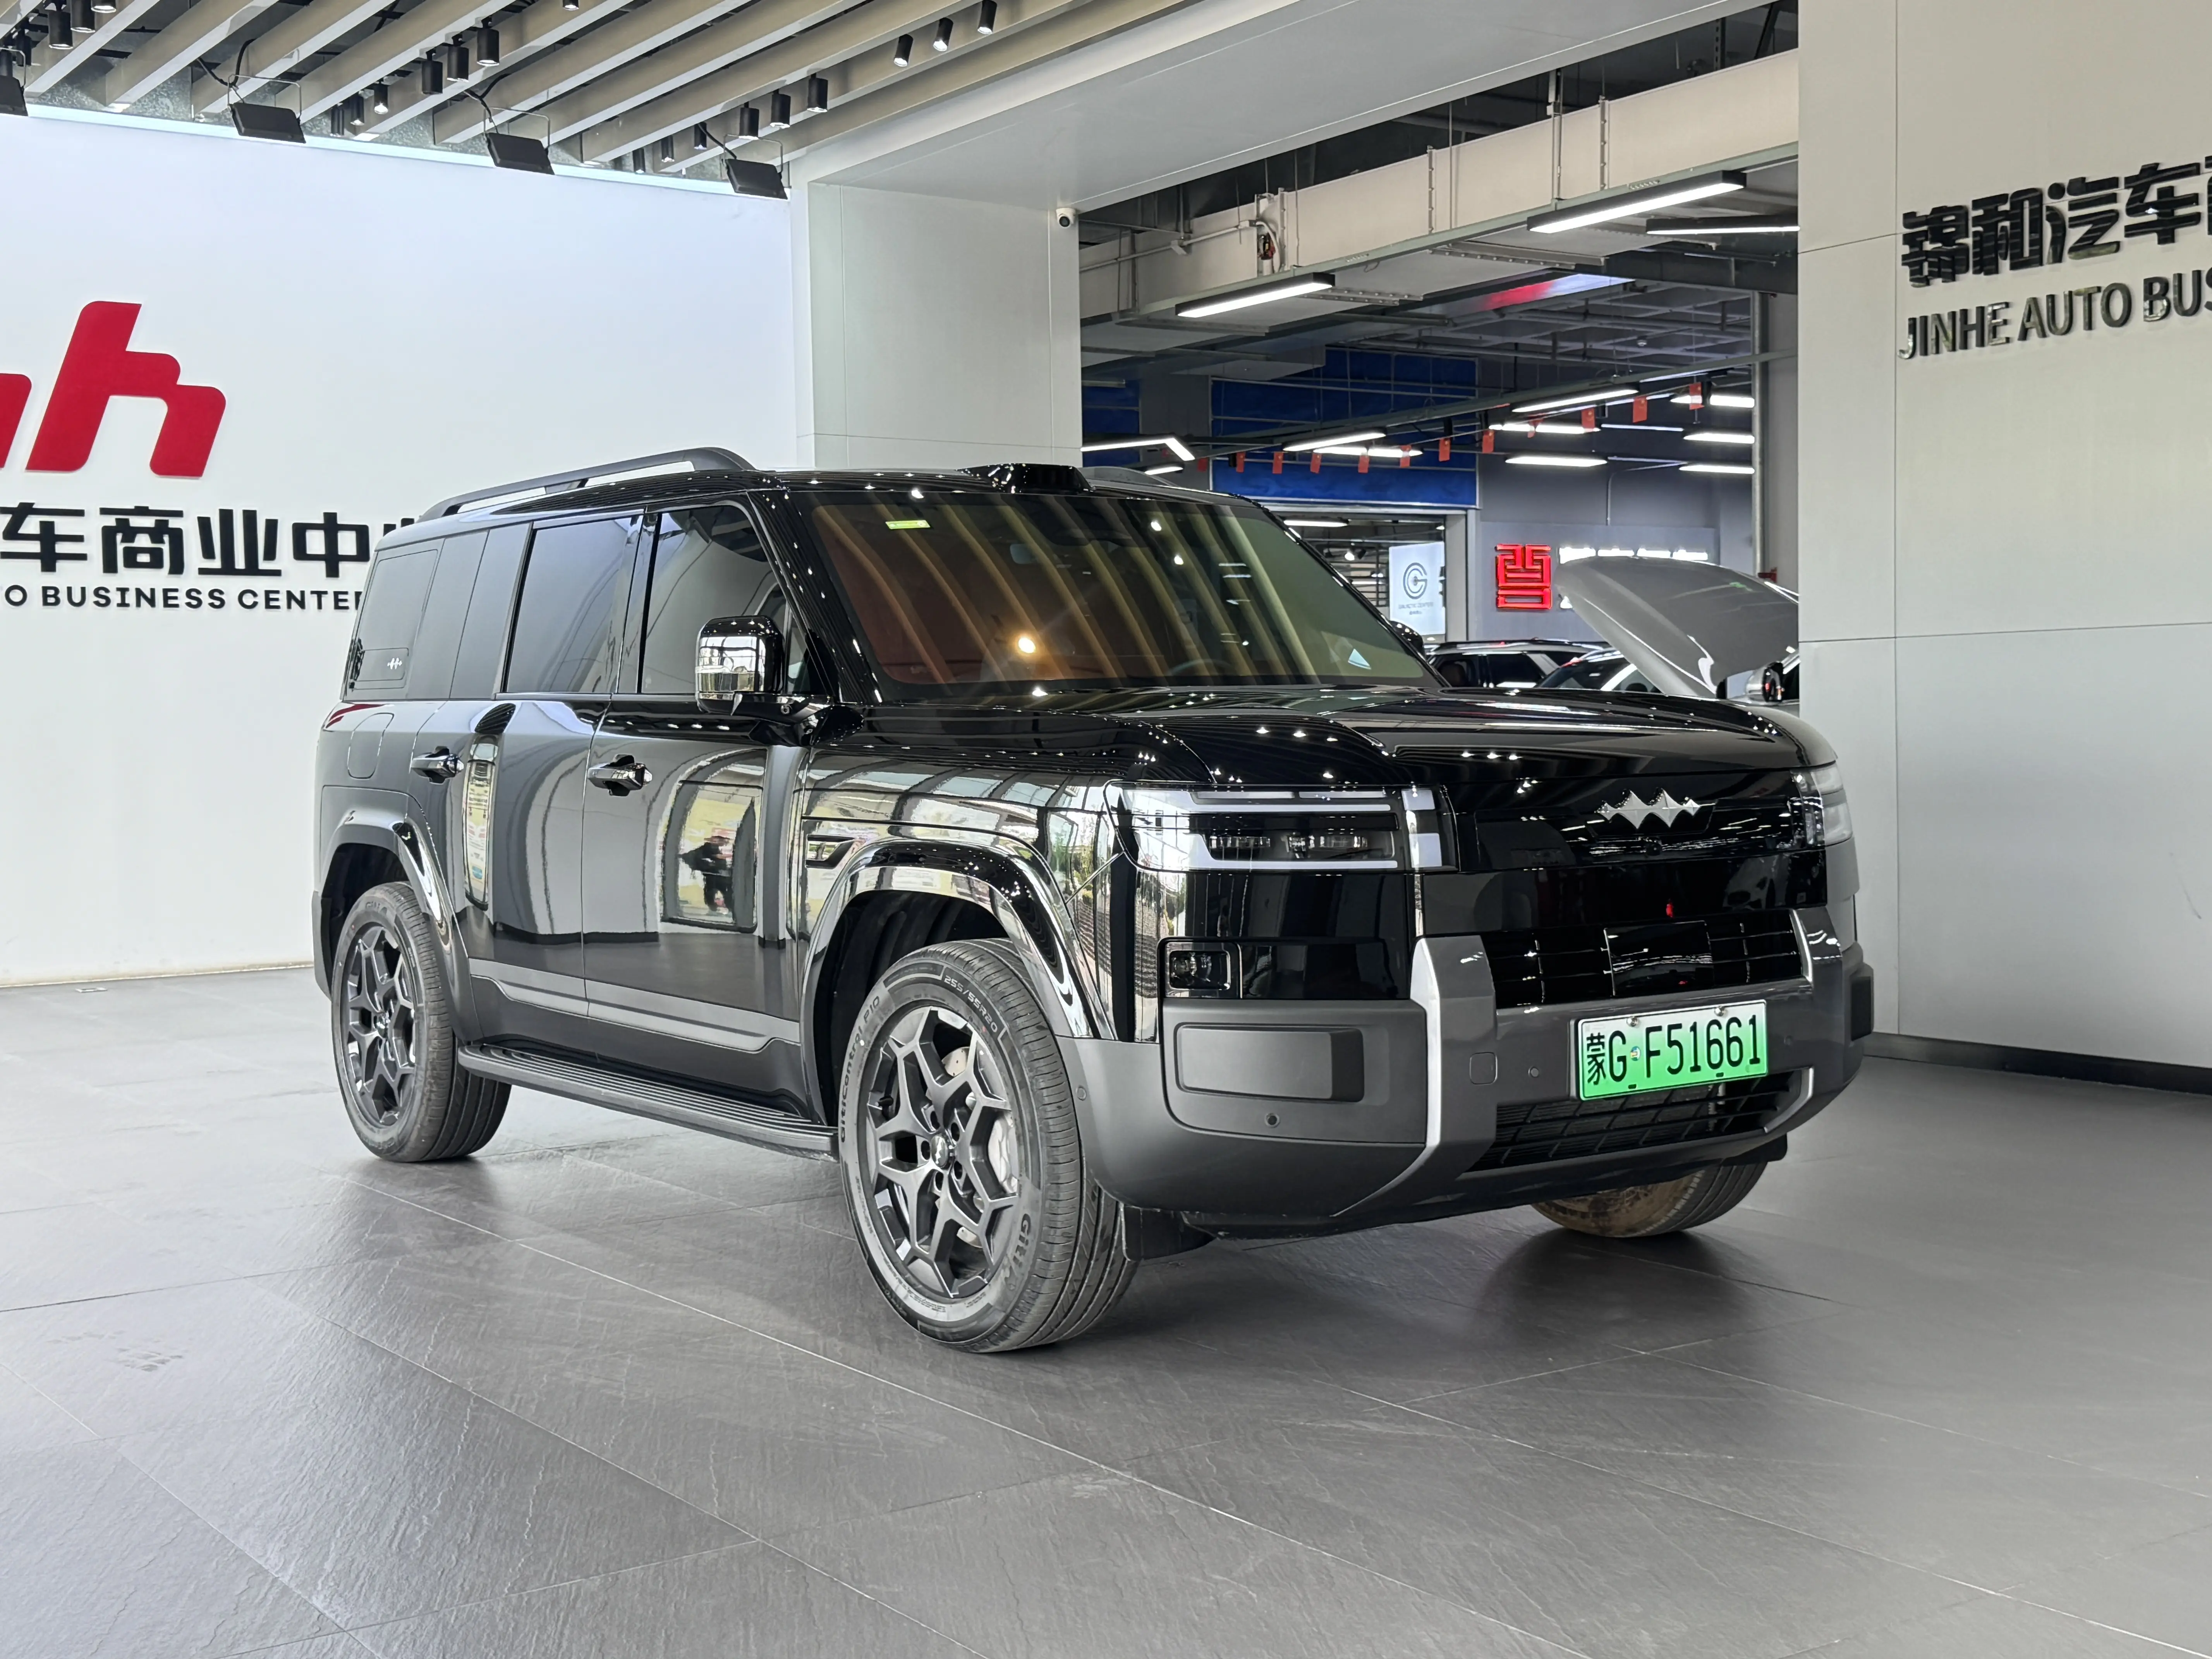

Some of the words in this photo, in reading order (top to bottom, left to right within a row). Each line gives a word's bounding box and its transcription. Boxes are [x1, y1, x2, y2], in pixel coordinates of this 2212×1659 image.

[1901, 156, 2212, 287] 锦和汽车
[1898, 301, 2010, 359] JINHE
[2018, 282, 2132, 341] AUTO
[0, 502, 415, 578] 车商业中
[41, 586, 226, 610] BUSINESS
[944, 975, 998, 1033] 255/55R20
[1645, 1014, 1760, 1078] F51661
[840, 1026, 864, 1143] GitiControl
[1013, 1213, 1031, 1268] Giti
